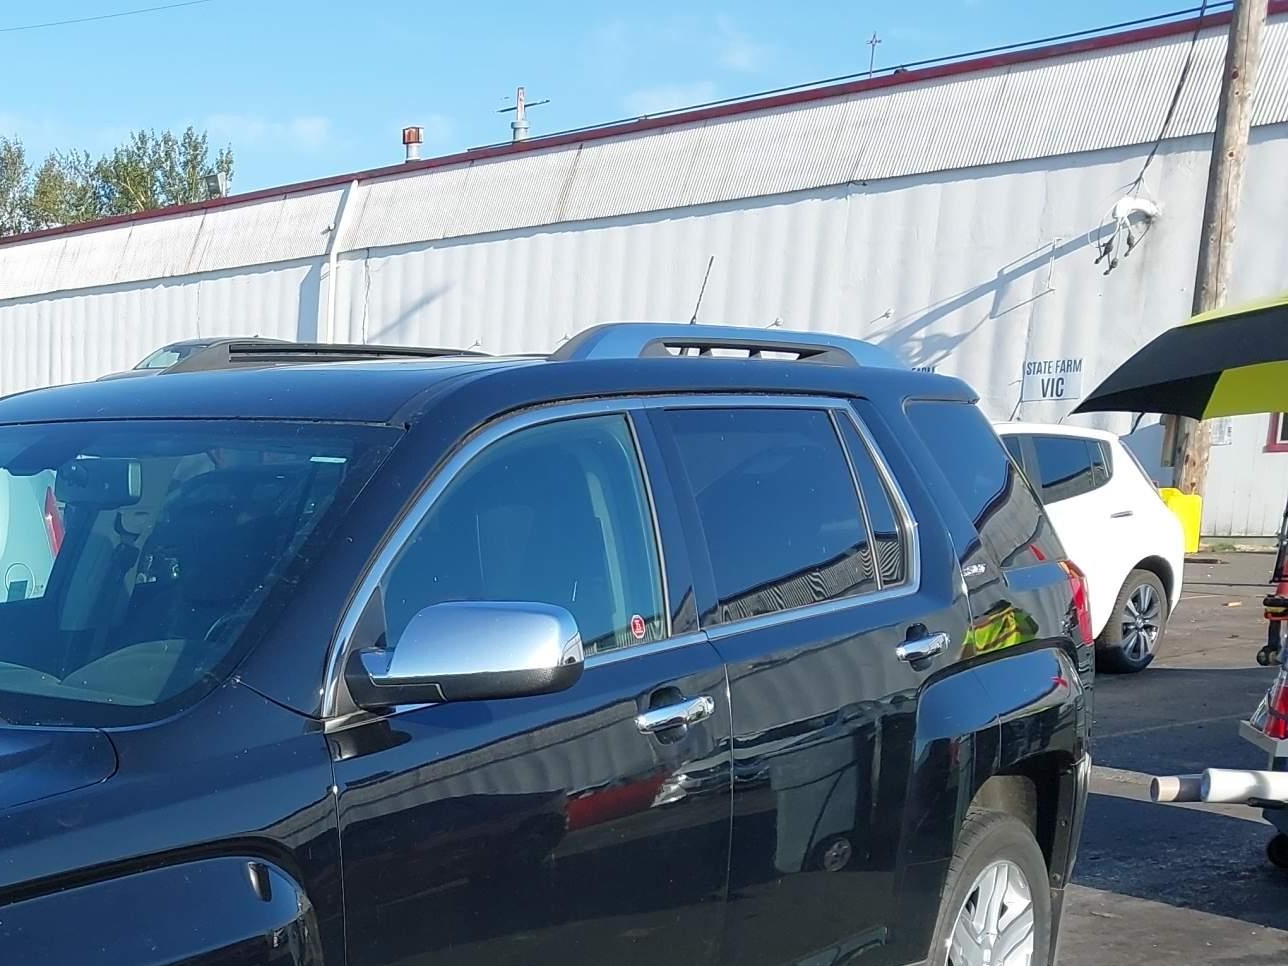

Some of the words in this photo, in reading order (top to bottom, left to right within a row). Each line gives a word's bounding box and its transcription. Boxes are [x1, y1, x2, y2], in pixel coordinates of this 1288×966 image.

[1026, 360, 1053, 376] STATE
[1055, 359, 1082, 374] FARM
[1041, 377, 1065, 398] VIC
